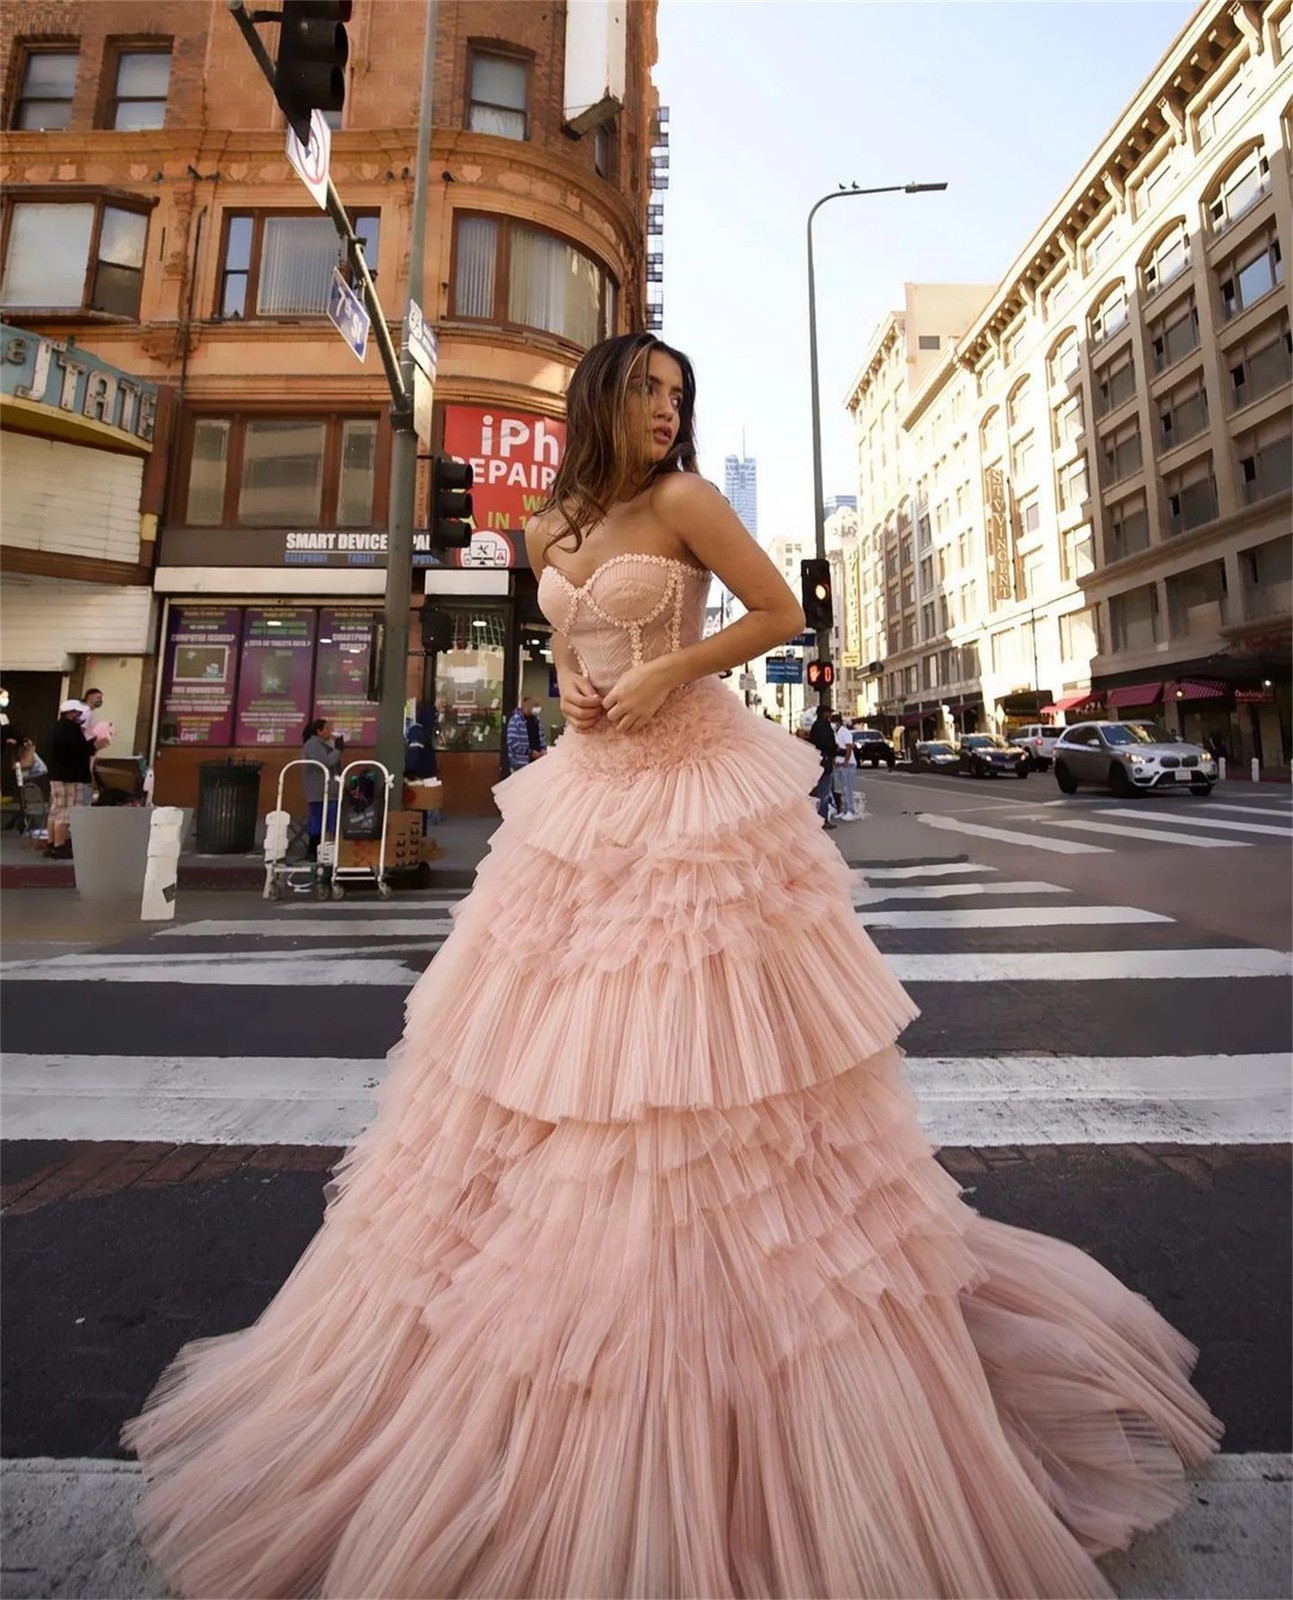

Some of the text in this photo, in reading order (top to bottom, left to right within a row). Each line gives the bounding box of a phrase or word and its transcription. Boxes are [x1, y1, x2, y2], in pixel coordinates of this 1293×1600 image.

[481, 414, 560, 467] iPh
[451, 456, 557, 490] EPAIR
[487, 511, 510, 530] IN
[286, 533, 336, 550] SMART
[337, 533, 388, 550] DEVICE
[332, 633, 372, 642] SMARTPHON
